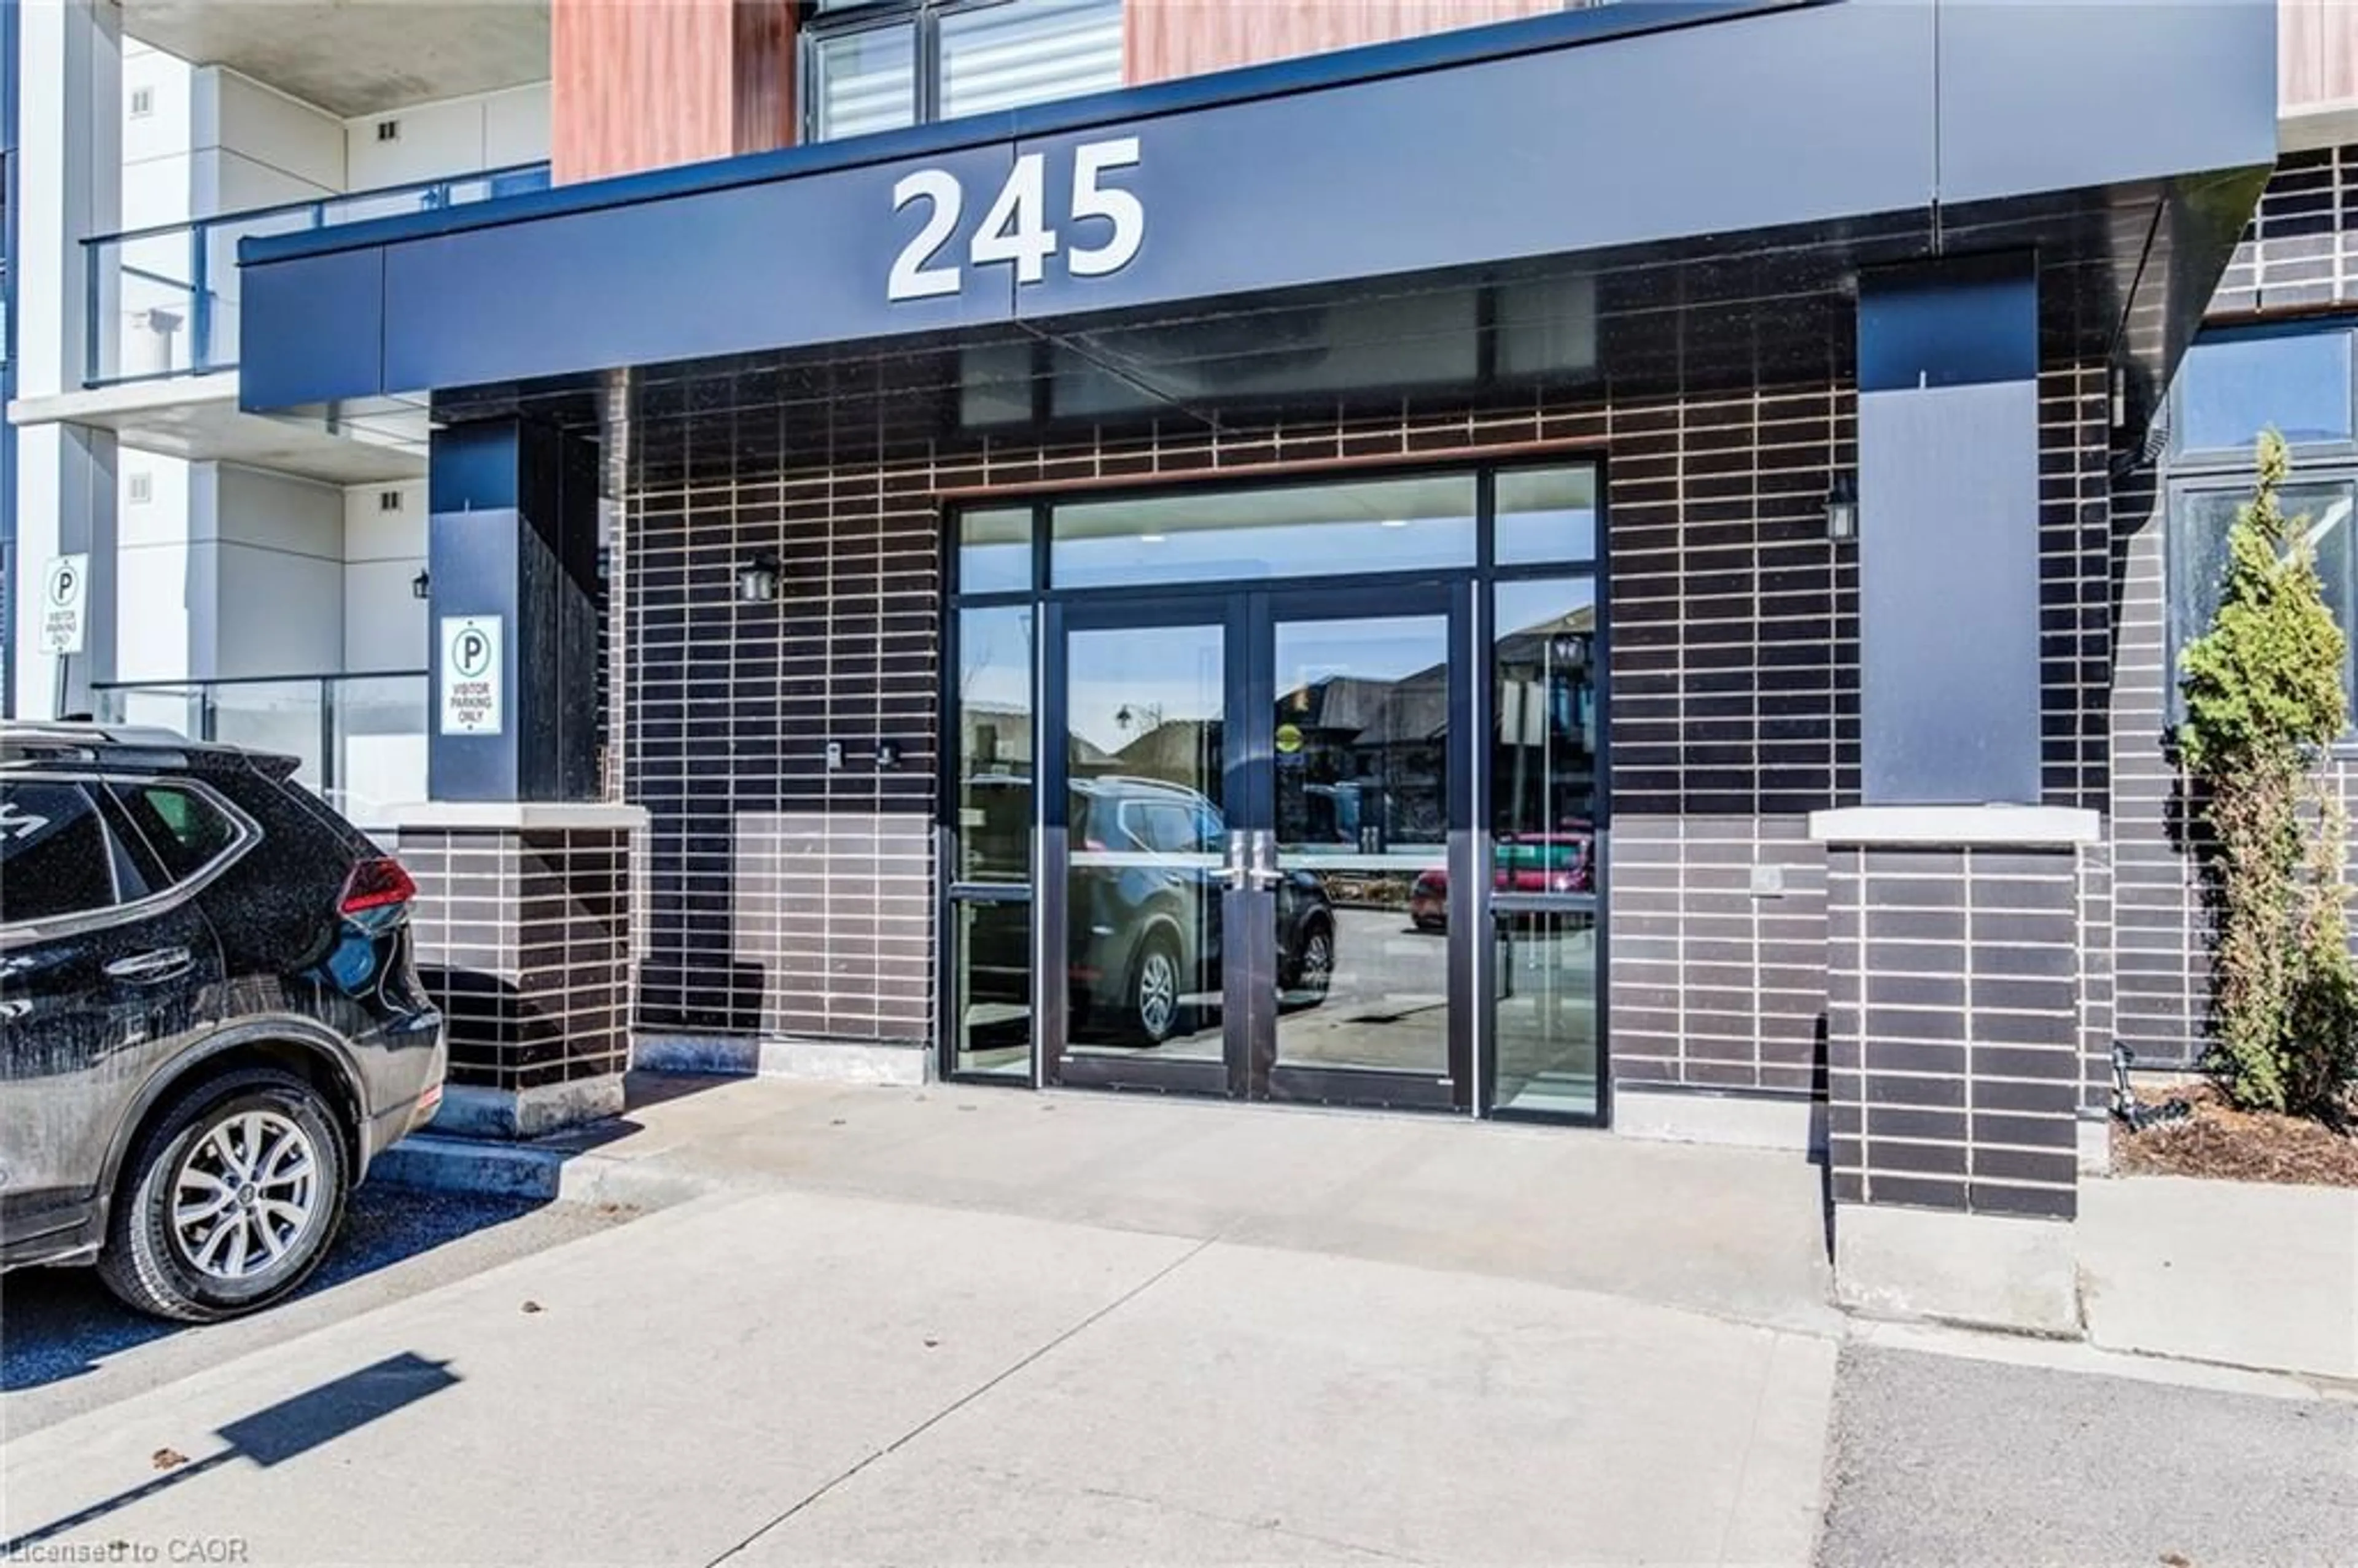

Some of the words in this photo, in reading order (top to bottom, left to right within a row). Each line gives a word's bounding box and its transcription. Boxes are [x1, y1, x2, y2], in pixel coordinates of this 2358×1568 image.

[887, 136, 1145, 302] 245
[58, 572, 72, 599] P
[464, 635, 482, 669] P
[453, 683, 490, 694] VISITOR
[451, 696, 492, 708] PARKING
[458, 710, 483, 723] ONLY
